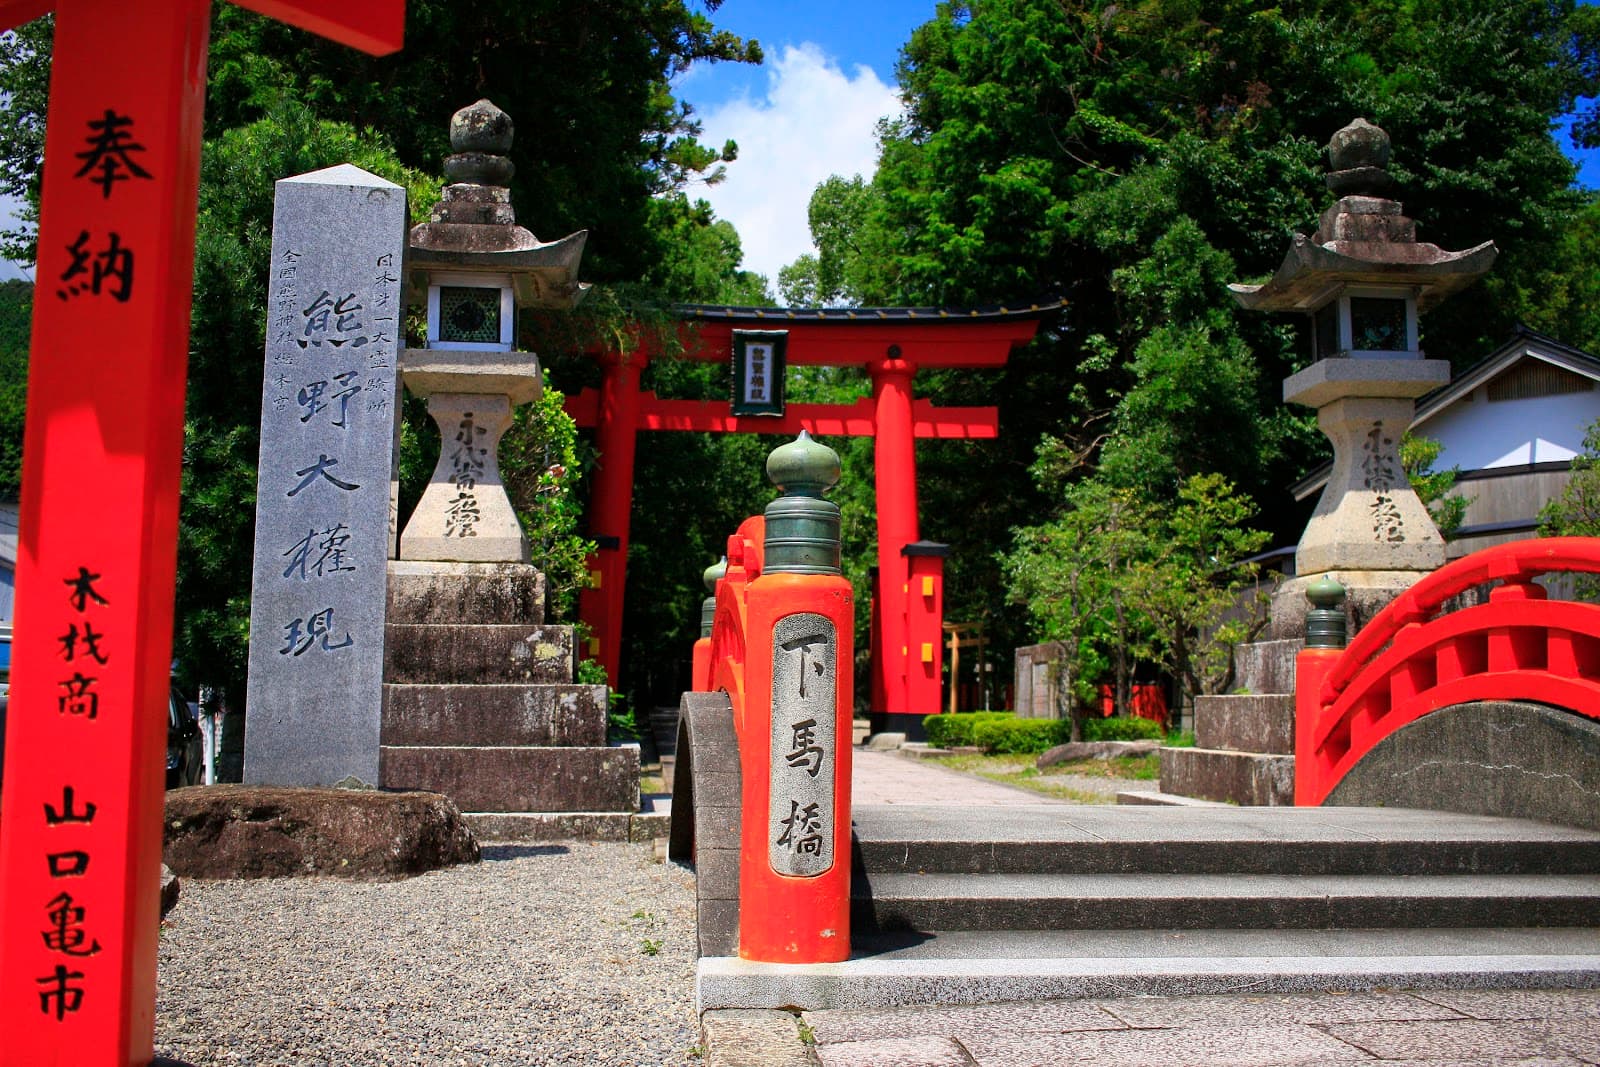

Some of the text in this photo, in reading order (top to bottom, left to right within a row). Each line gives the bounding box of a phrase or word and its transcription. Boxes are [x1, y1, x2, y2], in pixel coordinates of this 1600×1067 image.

[55, 108, 155, 303] 奉納
[776, 633, 828, 857] 下馬橋
[36, 786, 102, 1022] 山口亀市
